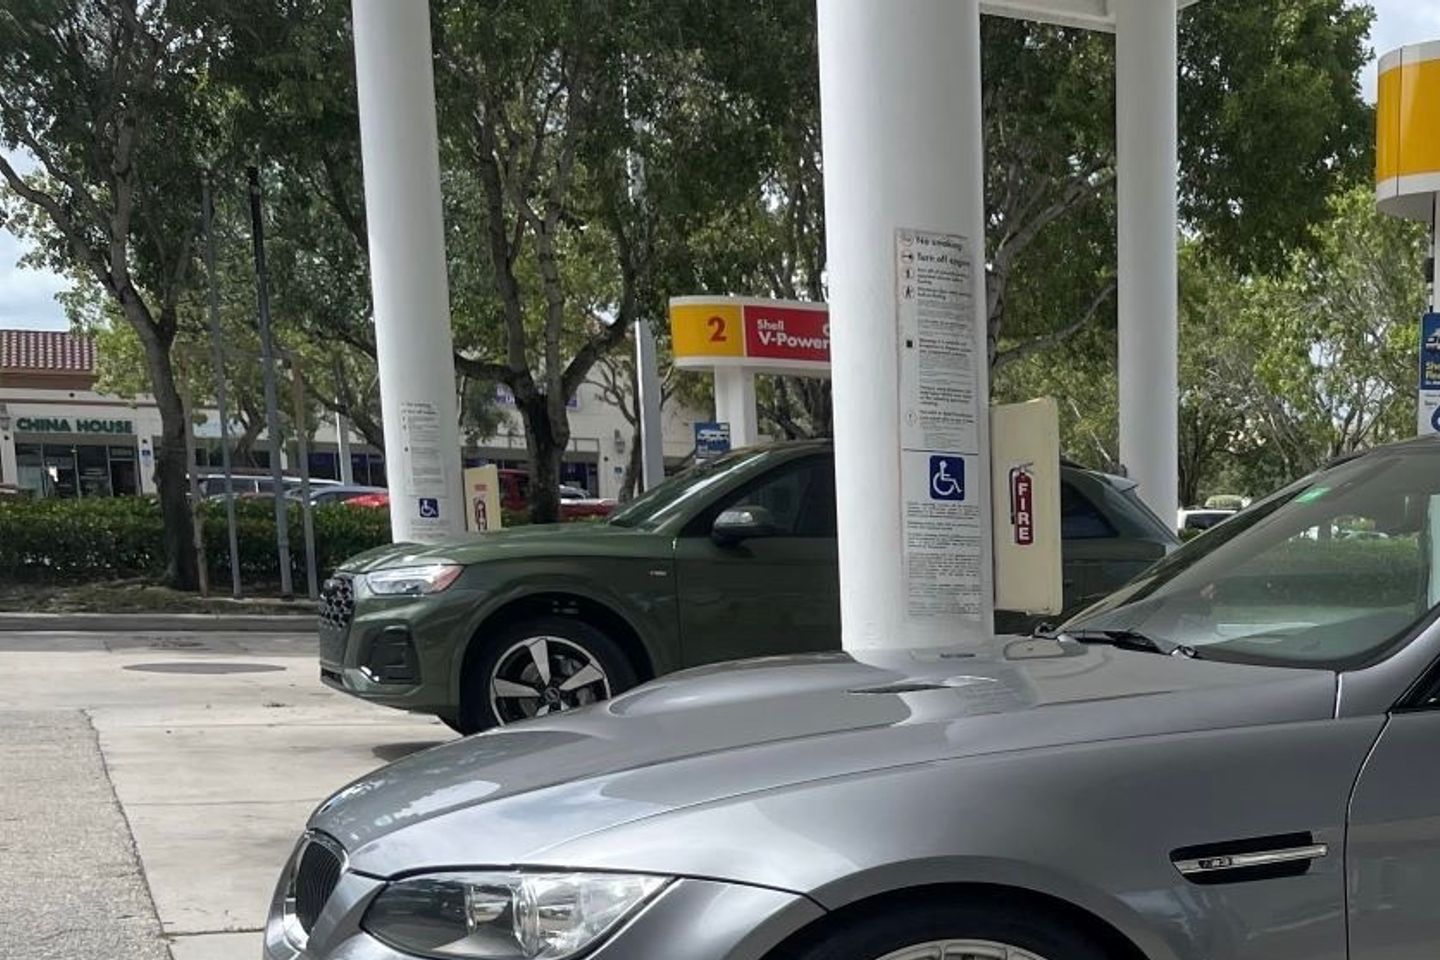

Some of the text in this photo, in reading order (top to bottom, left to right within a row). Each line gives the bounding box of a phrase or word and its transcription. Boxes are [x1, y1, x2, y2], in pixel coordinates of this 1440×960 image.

[708, 316, 727, 342] 2
[757, 319, 784, 330] Shell
[16, 417, 133, 434] CHINA HOUSE
[1018, 482, 1030, 541] FIRE
